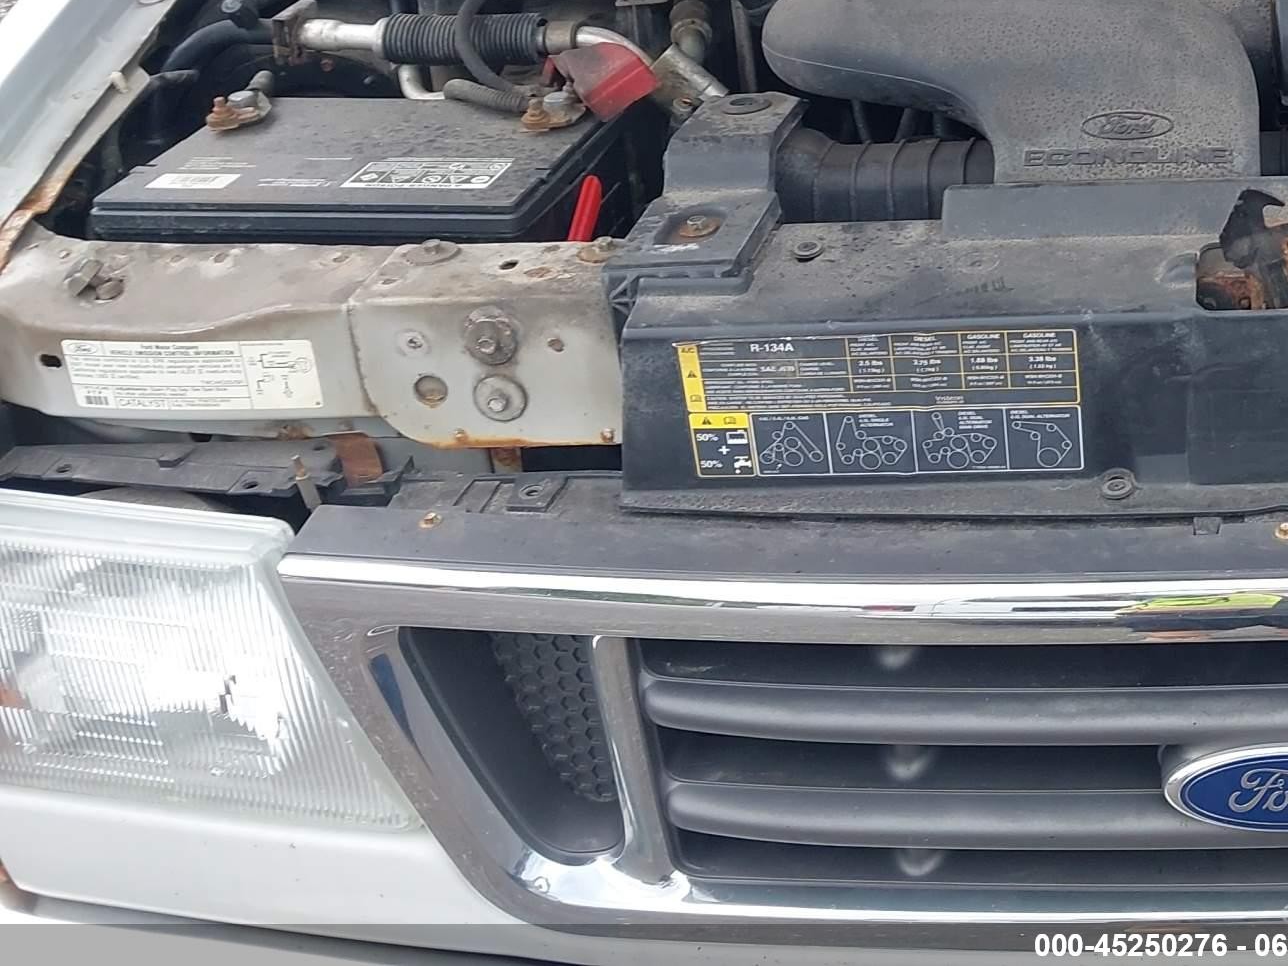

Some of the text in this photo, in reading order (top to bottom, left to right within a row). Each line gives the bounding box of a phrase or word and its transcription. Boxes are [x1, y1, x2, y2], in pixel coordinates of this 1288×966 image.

[1097, 113, 1158, 136] Ford
[1023, 146, 1234, 167] ECONOLINE
[750, 344, 794, 353] R-134A
[696, 434, 720, 442] 50%
[700, 460, 723, 468] 50%
